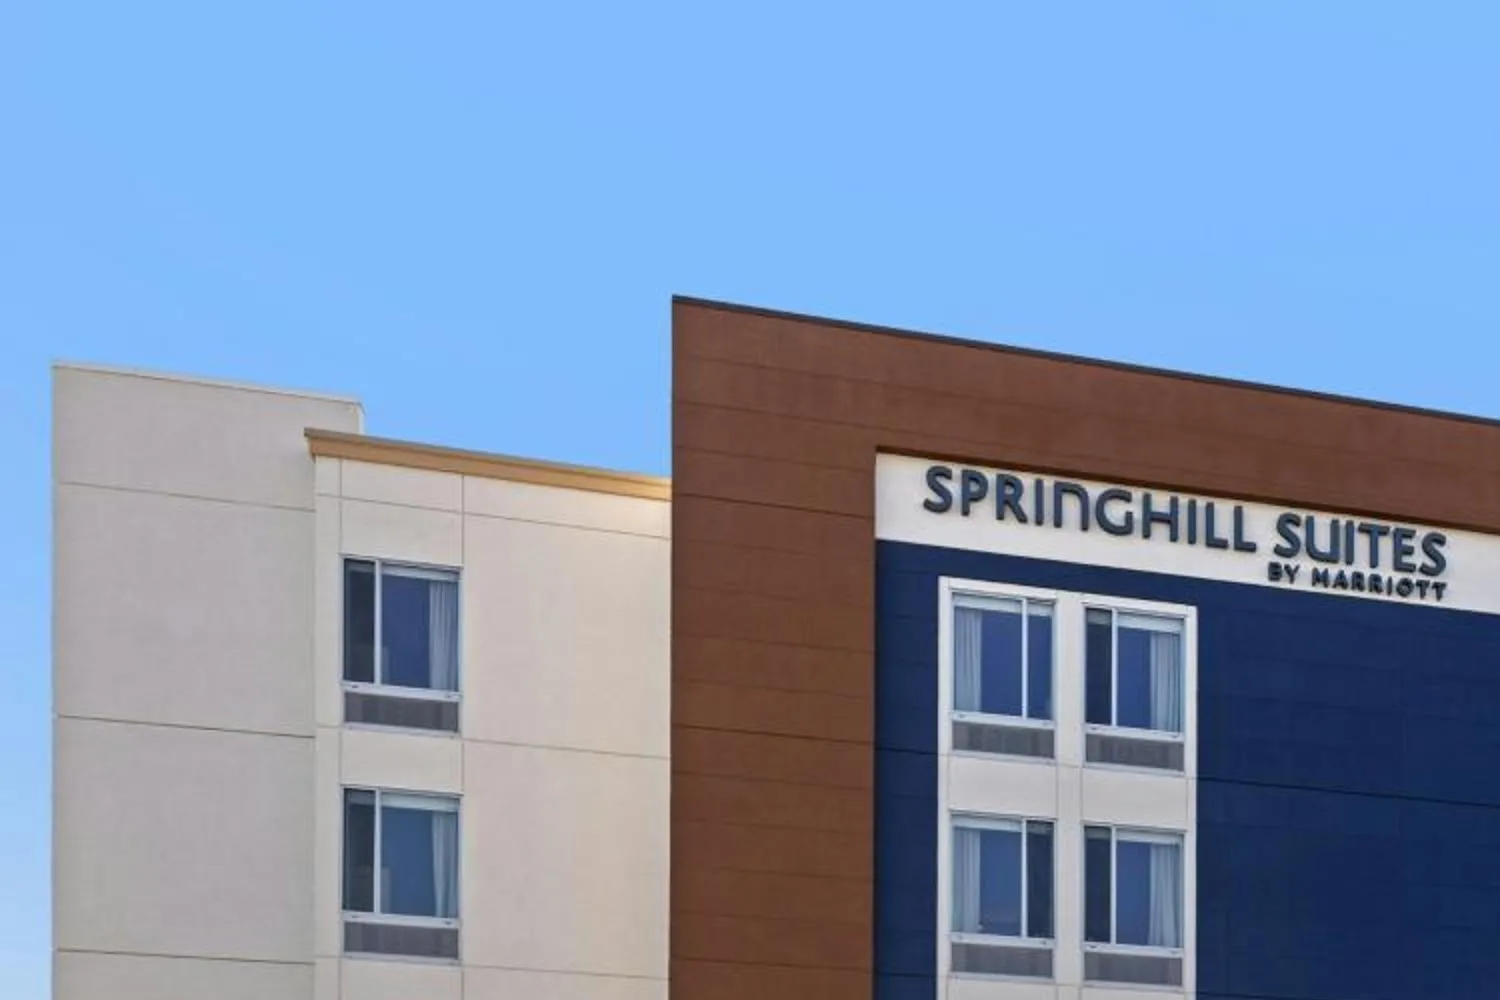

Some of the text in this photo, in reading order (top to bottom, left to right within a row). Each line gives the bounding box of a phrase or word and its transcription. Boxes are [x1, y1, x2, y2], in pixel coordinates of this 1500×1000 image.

[923, 465, 1447, 576] SPRINGHILL SUITES
[1267, 561, 1447, 601] BY MARRIOTT
